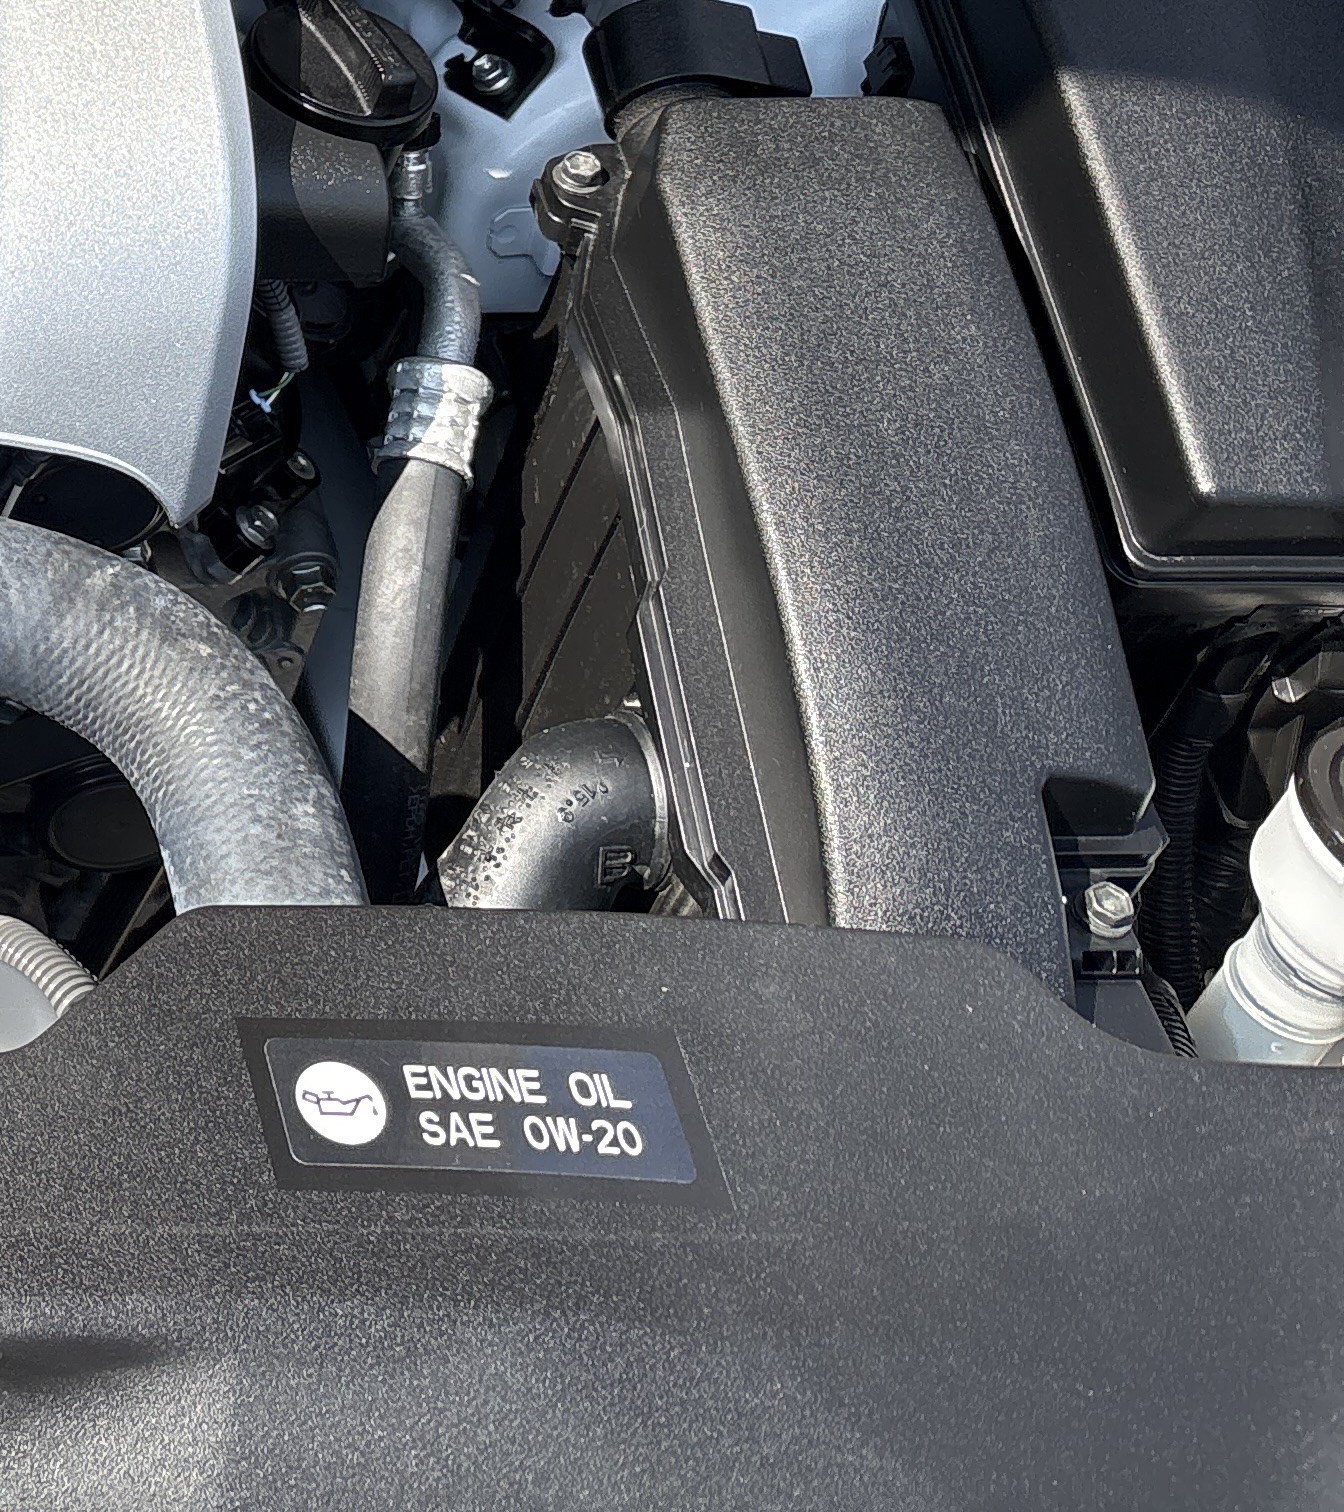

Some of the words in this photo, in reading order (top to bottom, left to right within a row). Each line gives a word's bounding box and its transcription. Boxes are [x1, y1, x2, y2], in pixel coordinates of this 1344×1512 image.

[402, 1063, 548, 1105] ENGINE
[568, 1071, 633, 1110] OIL
[419, 1110, 502, 1149] SAE
[522, 1115, 644, 1157] 0W-20
